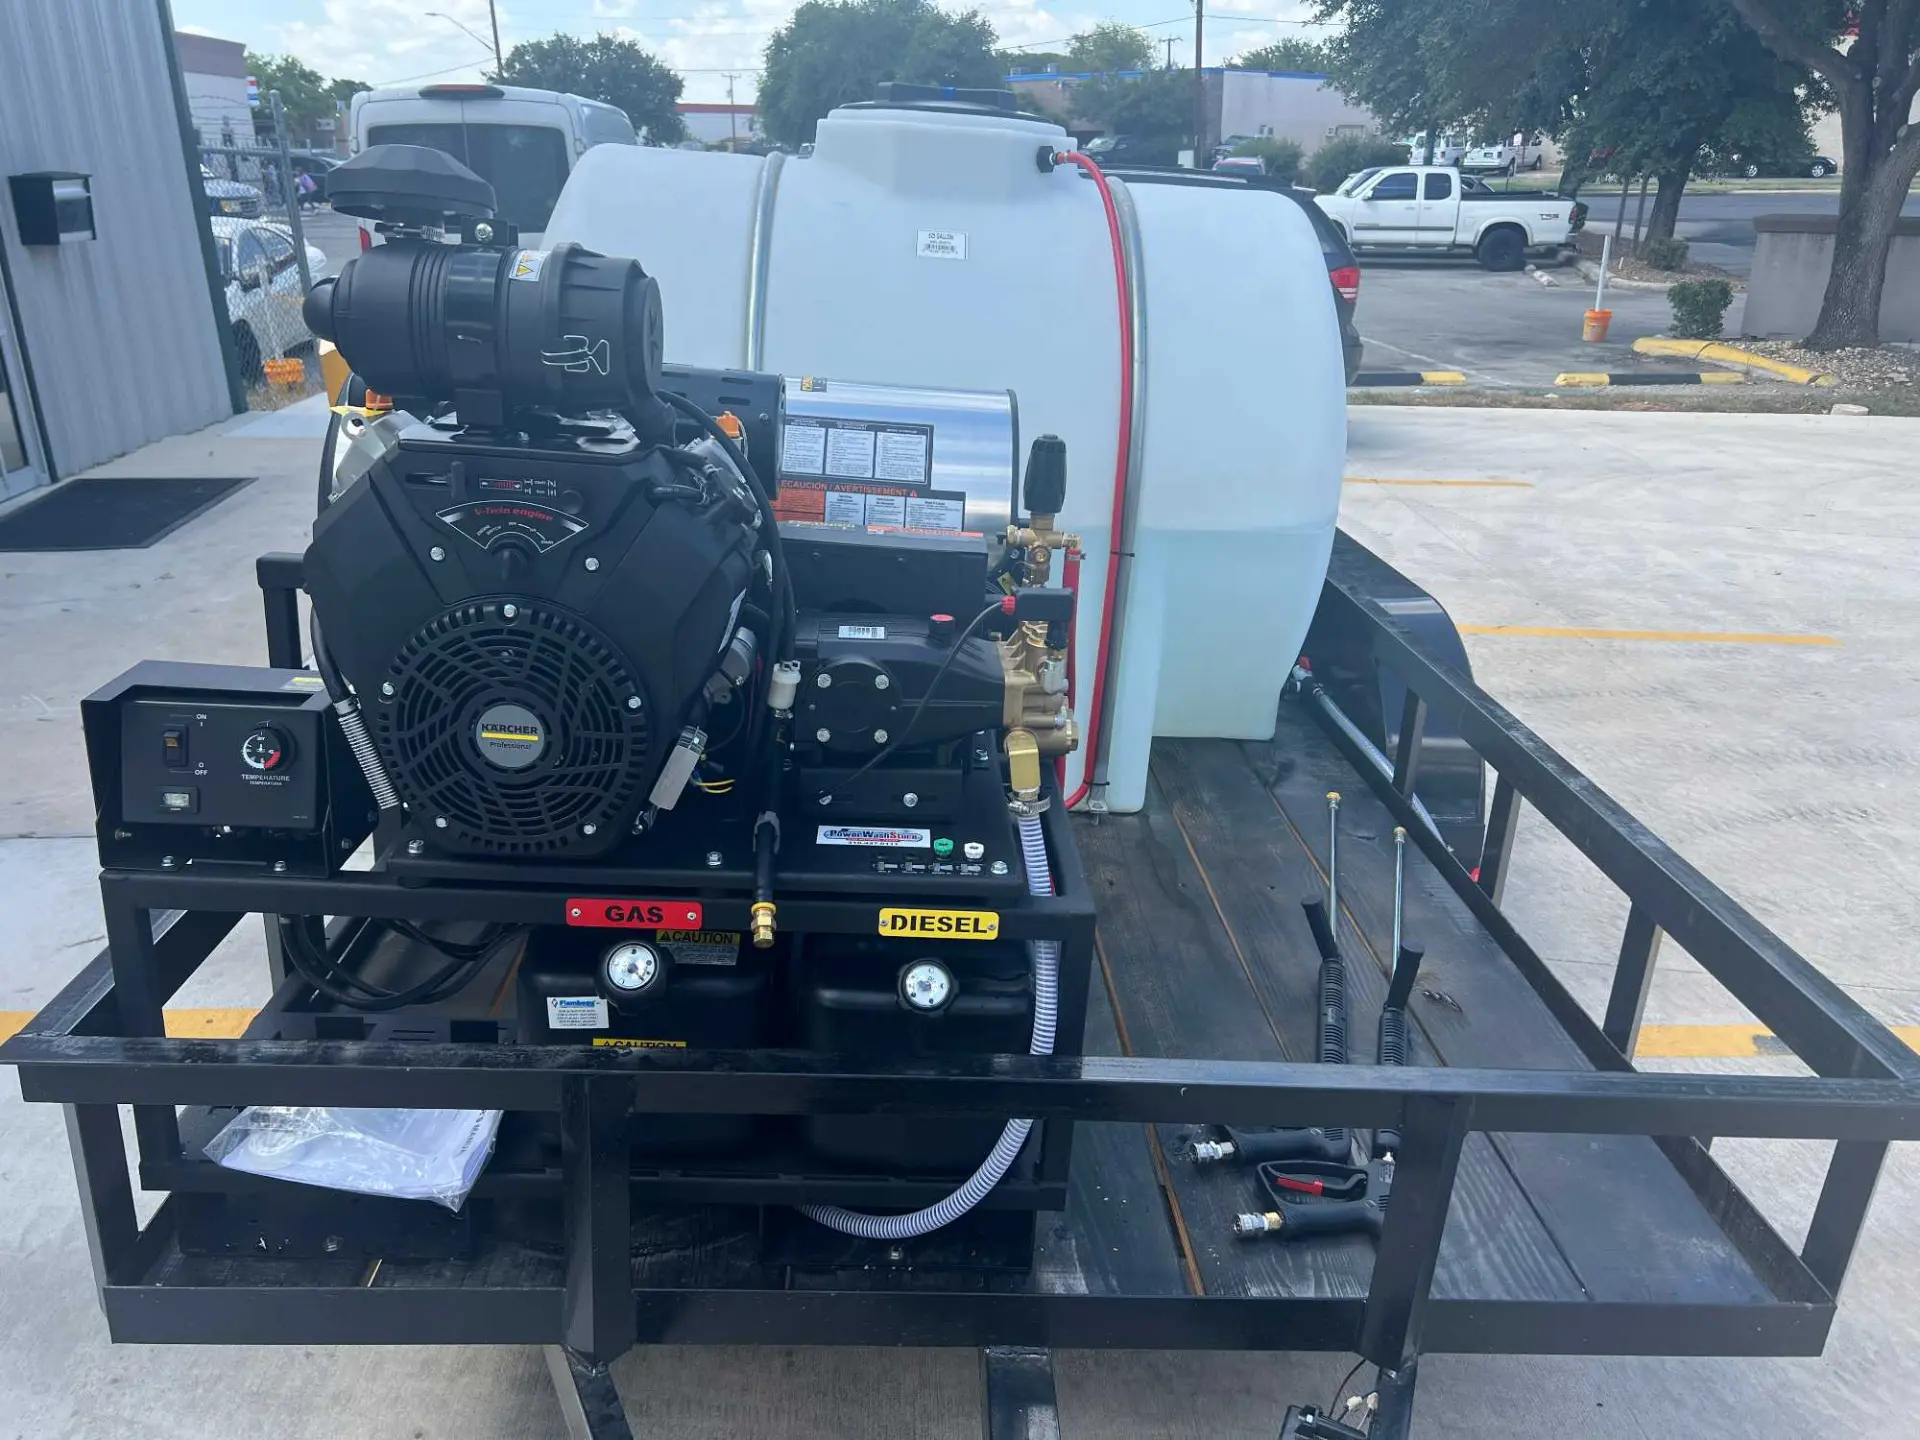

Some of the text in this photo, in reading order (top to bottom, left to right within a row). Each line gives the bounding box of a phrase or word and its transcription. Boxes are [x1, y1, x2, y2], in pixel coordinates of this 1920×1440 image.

[196, 713, 208, 721] ON
[194, 769, 208, 777] OFF
[241, 773, 291, 782] TEMPERATURE
[605, 905, 664, 923] GAS
[890, 914, 988, 934] DIESEL
[672, 931, 733, 944] CAUTION
